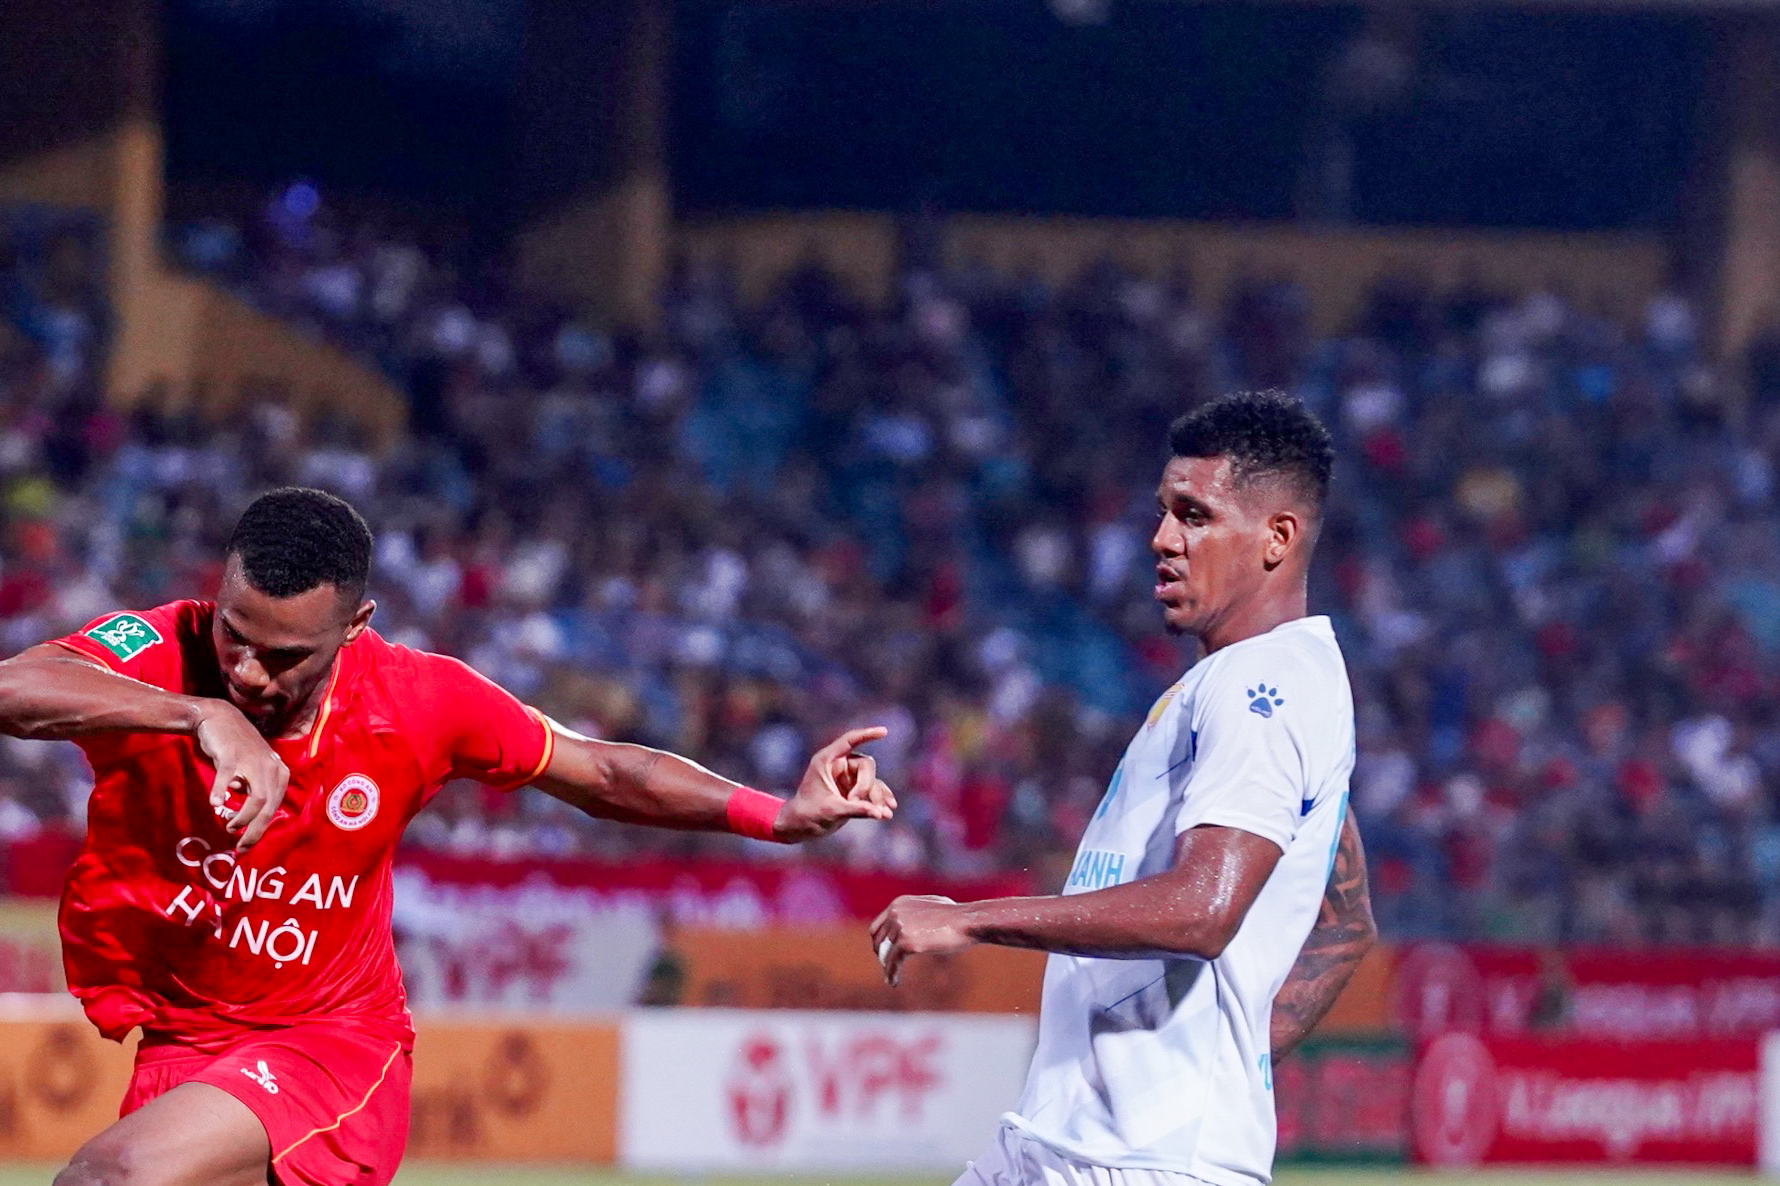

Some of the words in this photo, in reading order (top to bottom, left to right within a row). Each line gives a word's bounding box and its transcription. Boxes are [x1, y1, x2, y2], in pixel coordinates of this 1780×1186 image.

[289, 873, 359, 910] AN
[229, 916, 318, 969] NỘI
[804, 1028, 952, 1124] VPF
